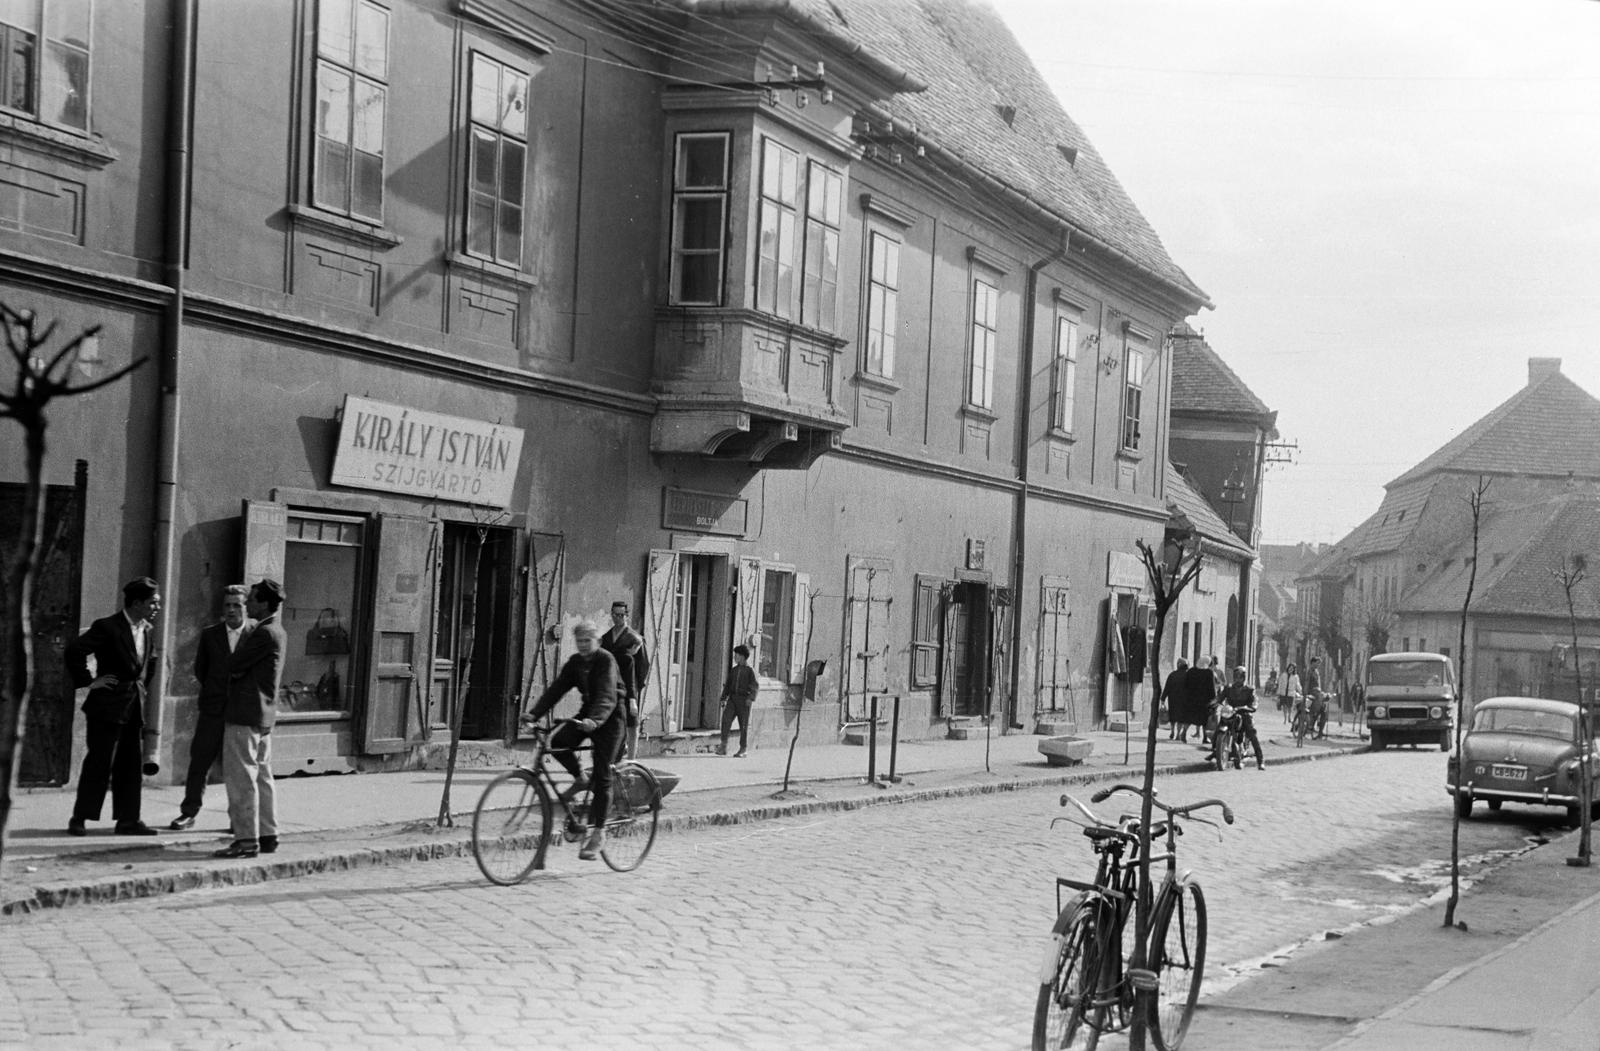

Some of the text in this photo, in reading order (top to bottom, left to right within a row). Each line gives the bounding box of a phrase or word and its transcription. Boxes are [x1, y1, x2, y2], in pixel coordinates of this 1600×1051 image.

[352, 410, 511, 472] KIRÁLY ISTVÁN
[372, 462, 482, 495] SZIJGYÁRTÓ
